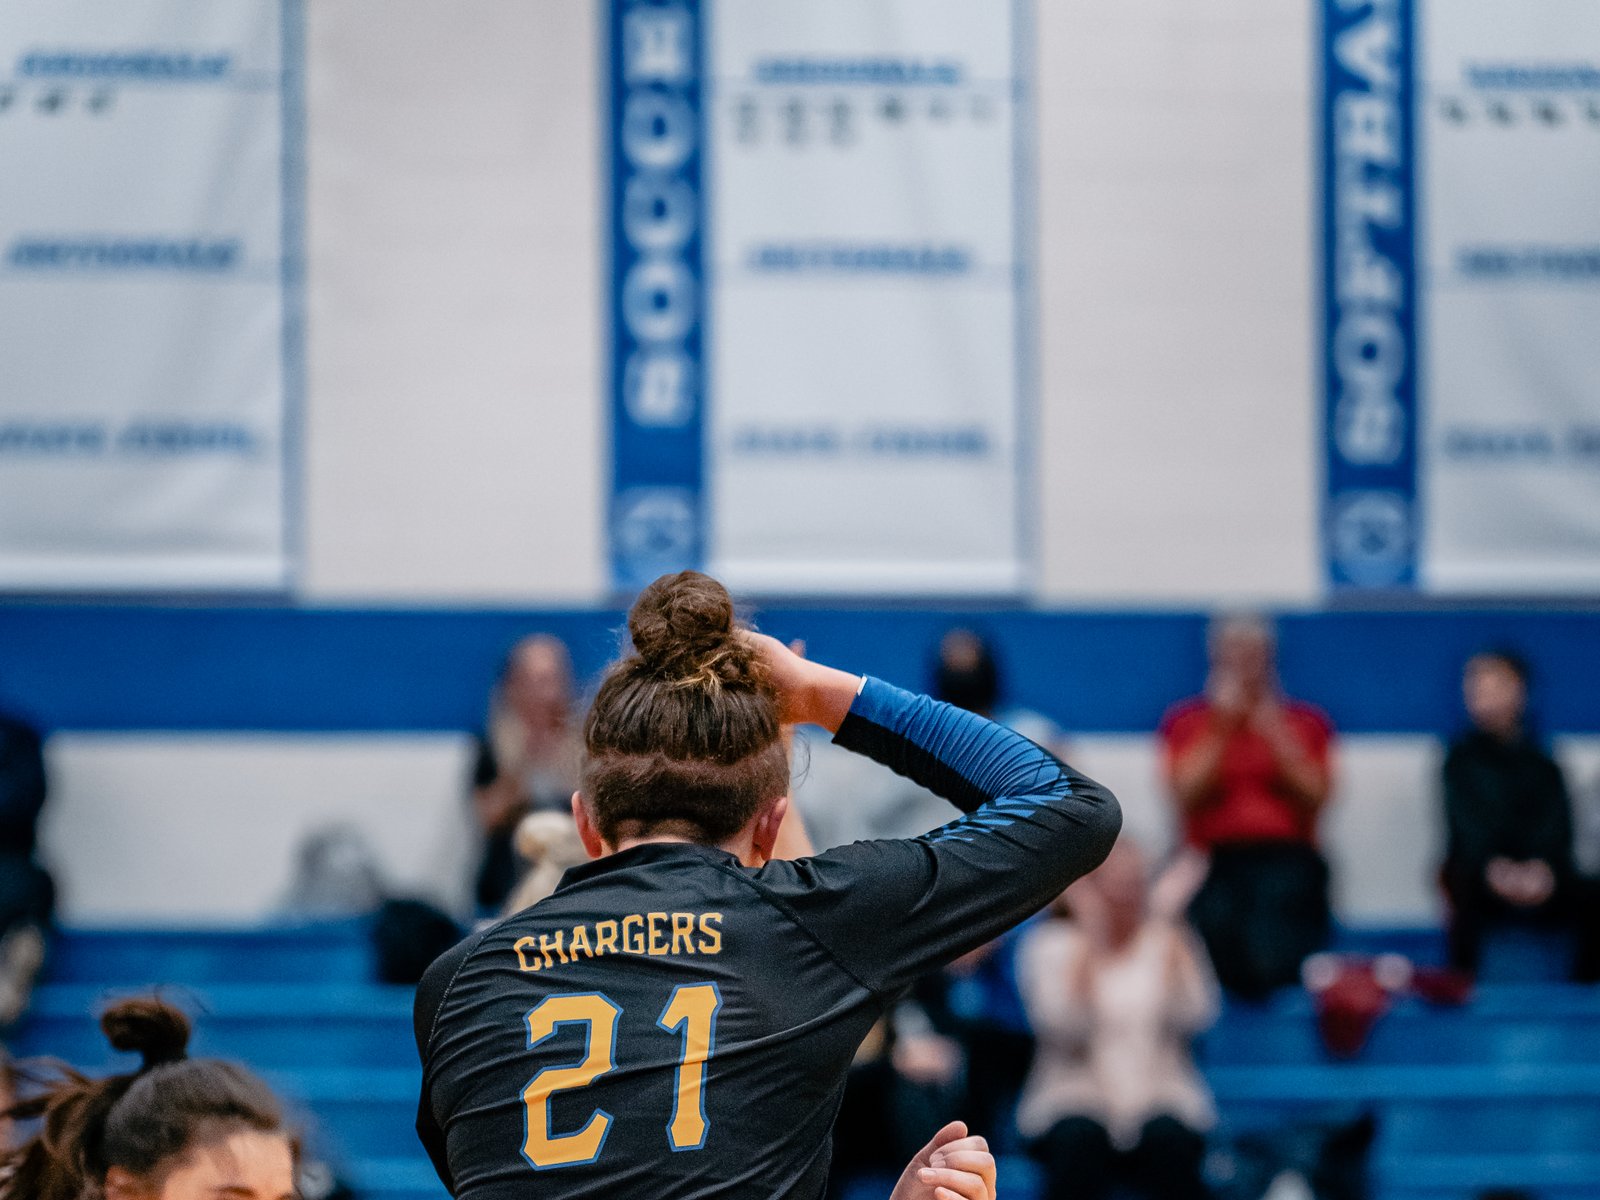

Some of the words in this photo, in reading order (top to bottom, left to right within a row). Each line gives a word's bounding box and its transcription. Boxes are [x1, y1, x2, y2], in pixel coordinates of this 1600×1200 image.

[621, 0, 700, 428] SOCCE
[1334, 0, 1406, 464] SOFTBA
[513, 912, 724, 972] CHARGERS
[519, 981, 724, 1172] 21
